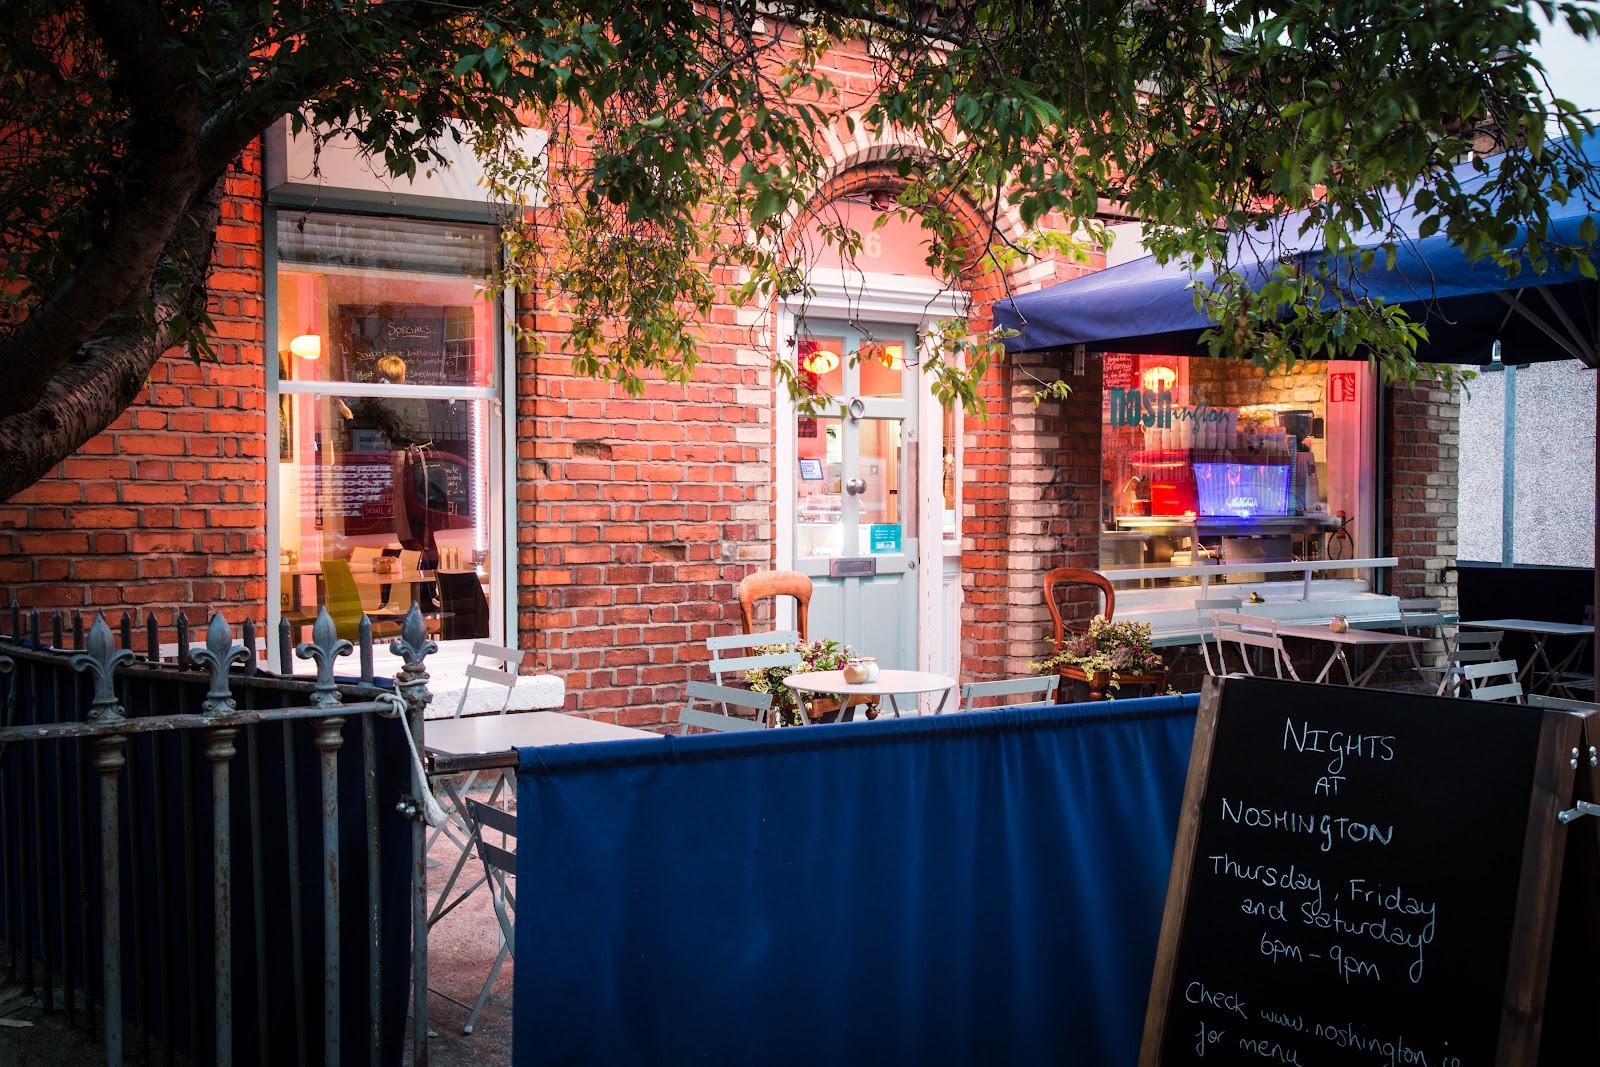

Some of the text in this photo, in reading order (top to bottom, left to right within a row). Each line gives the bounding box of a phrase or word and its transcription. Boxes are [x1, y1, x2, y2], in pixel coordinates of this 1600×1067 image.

[1315, 776, 1347, 797] AT
[1350, 878, 1436, 943] Friday
[1241, 899, 1424, 983] and Saturday
[1260, 932, 1303, 964] 6pm
[1330, 945, 1381, 984] 9pm
[1185, 981, 1248, 1020] Check
[1195, 1021, 1303, 1067] for menu
